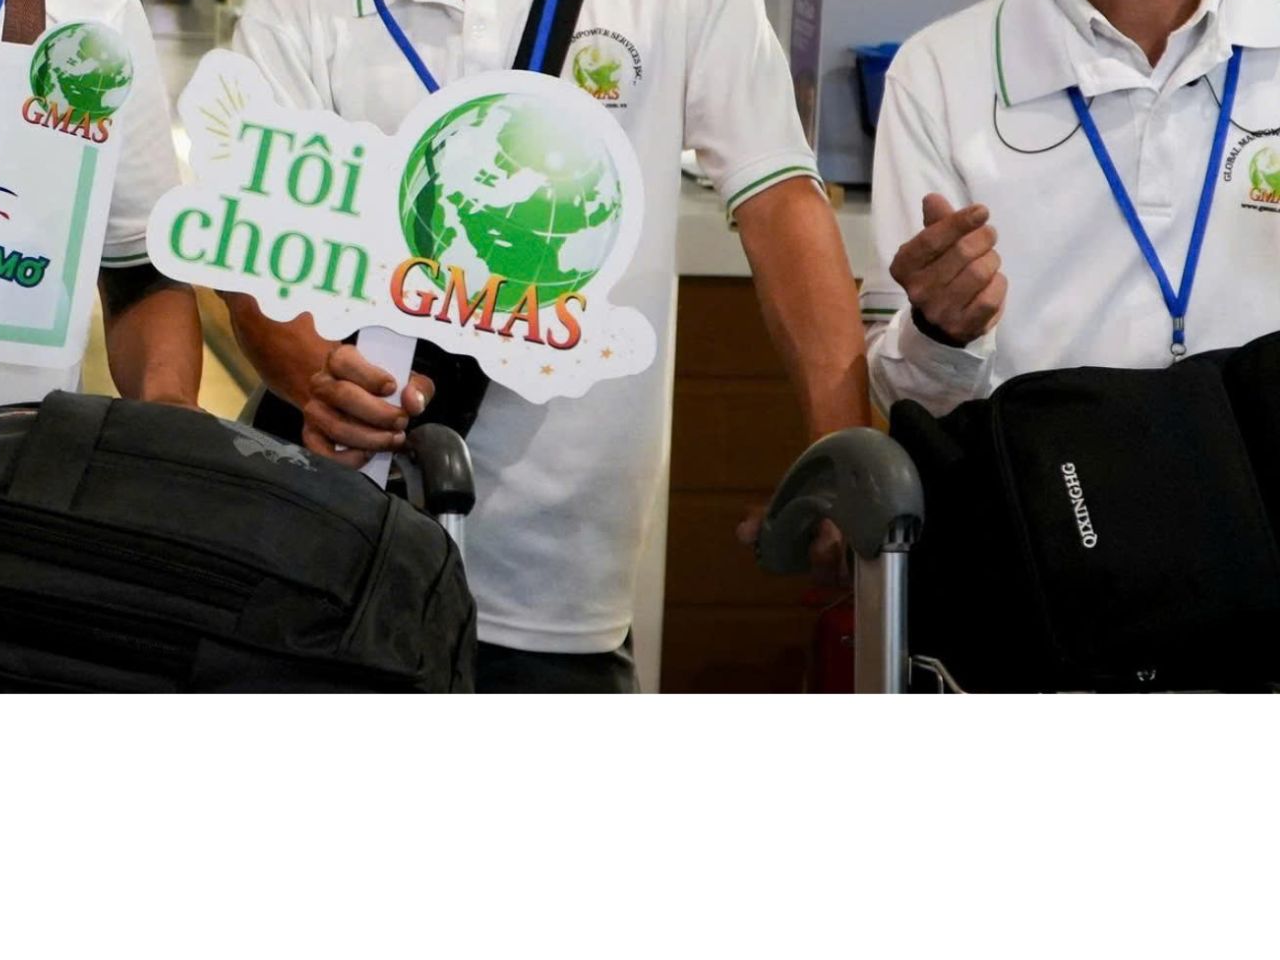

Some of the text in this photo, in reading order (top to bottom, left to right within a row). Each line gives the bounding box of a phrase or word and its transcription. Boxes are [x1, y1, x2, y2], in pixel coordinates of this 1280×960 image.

[22, 96, 113, 144] GMAS
[237, 121, 366, 218] Tôi
[168, 196, 371, 300] chọn
[389, 256, 588, 351] GMAS
[1061, 462, 1097, 548] QIXINGHG
